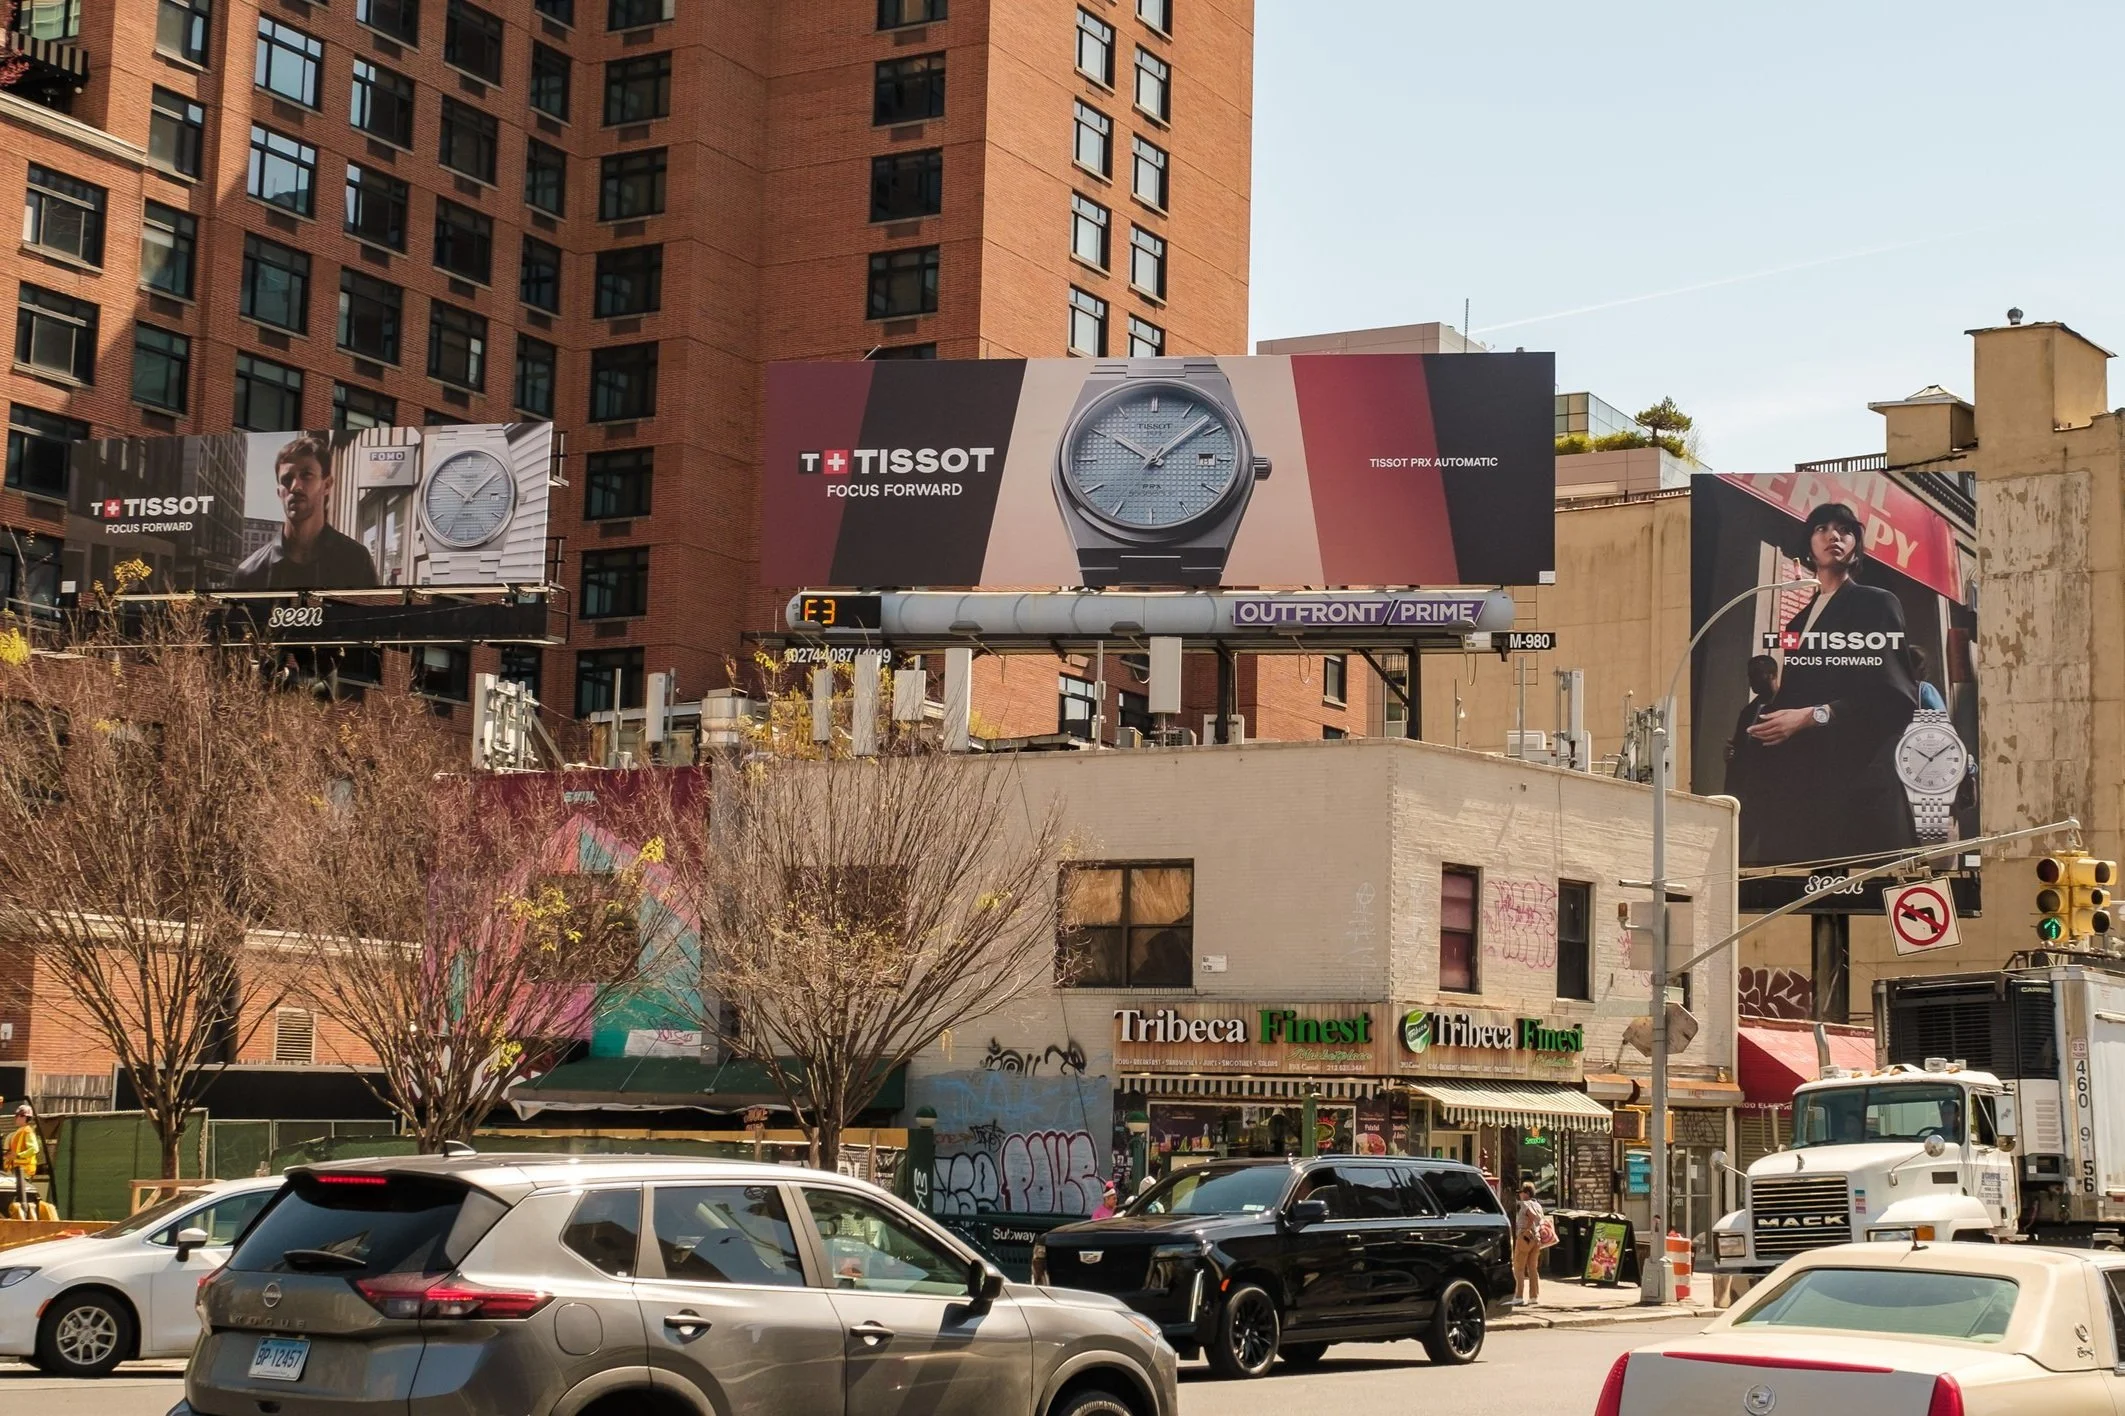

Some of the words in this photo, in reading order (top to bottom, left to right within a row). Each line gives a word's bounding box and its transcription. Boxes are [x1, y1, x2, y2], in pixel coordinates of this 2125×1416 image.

[853, 447, 995, 475] TISSOT
[1369, 458, 1408, 468] TISSOT
[1411, 458, 1432, 467] PRX
[1434, 457, 1499, 467] AUTOMATIC
[827, 484, 880, 497] FOCUS
[884, 483, 963, 496] FORWARD
[124, 496, 215, 517] TISSOT
[105, 523, 140, 534] FOCUS
[142, 521, 193, 532] FORWARD
[268, 606, 323, 628] seen
[1239, 602, 1384, 623] OUTFRONT
[1401, 603, 1475, 622] PRIME
[1509, 633, 1551, 649] M-980
[1804, 632, 1905, 650] TISSOT
[1783, 656, 1823, 667] FOCUS
[1825, 656, 1883, 667] FORWARD
[1113, 1009, 1248, 1044] Tribeca
[1257, 1009, 1373, 1045] Finest
[1432, 1011, 1516, 1050] Tribeca
[1521, 1017, 1585, 1052] Finest
[1758, 1215, 1846, 1227] MACK
